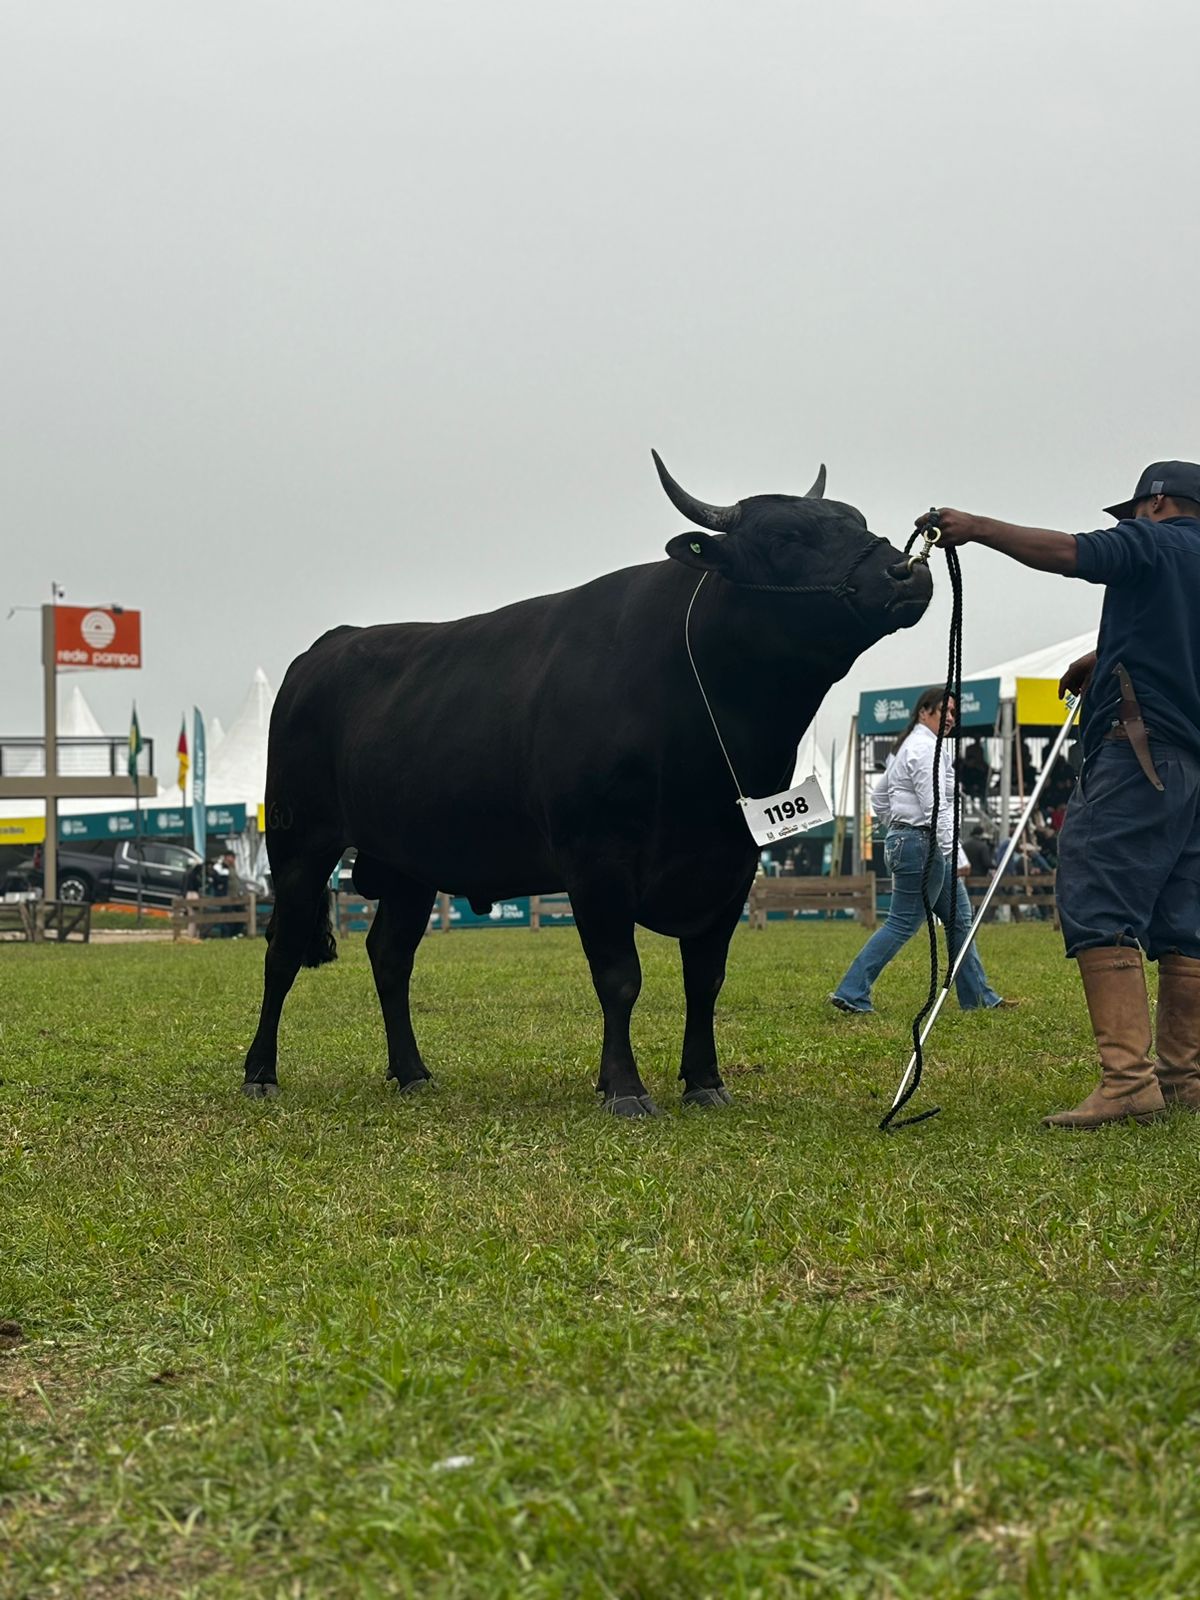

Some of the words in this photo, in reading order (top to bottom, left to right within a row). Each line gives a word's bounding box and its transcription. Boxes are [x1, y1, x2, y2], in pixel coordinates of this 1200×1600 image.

[57, 649, 88, 662] rede
[92, 651, 138, 666] pampa
[763, 796, 809, 825] 1198
